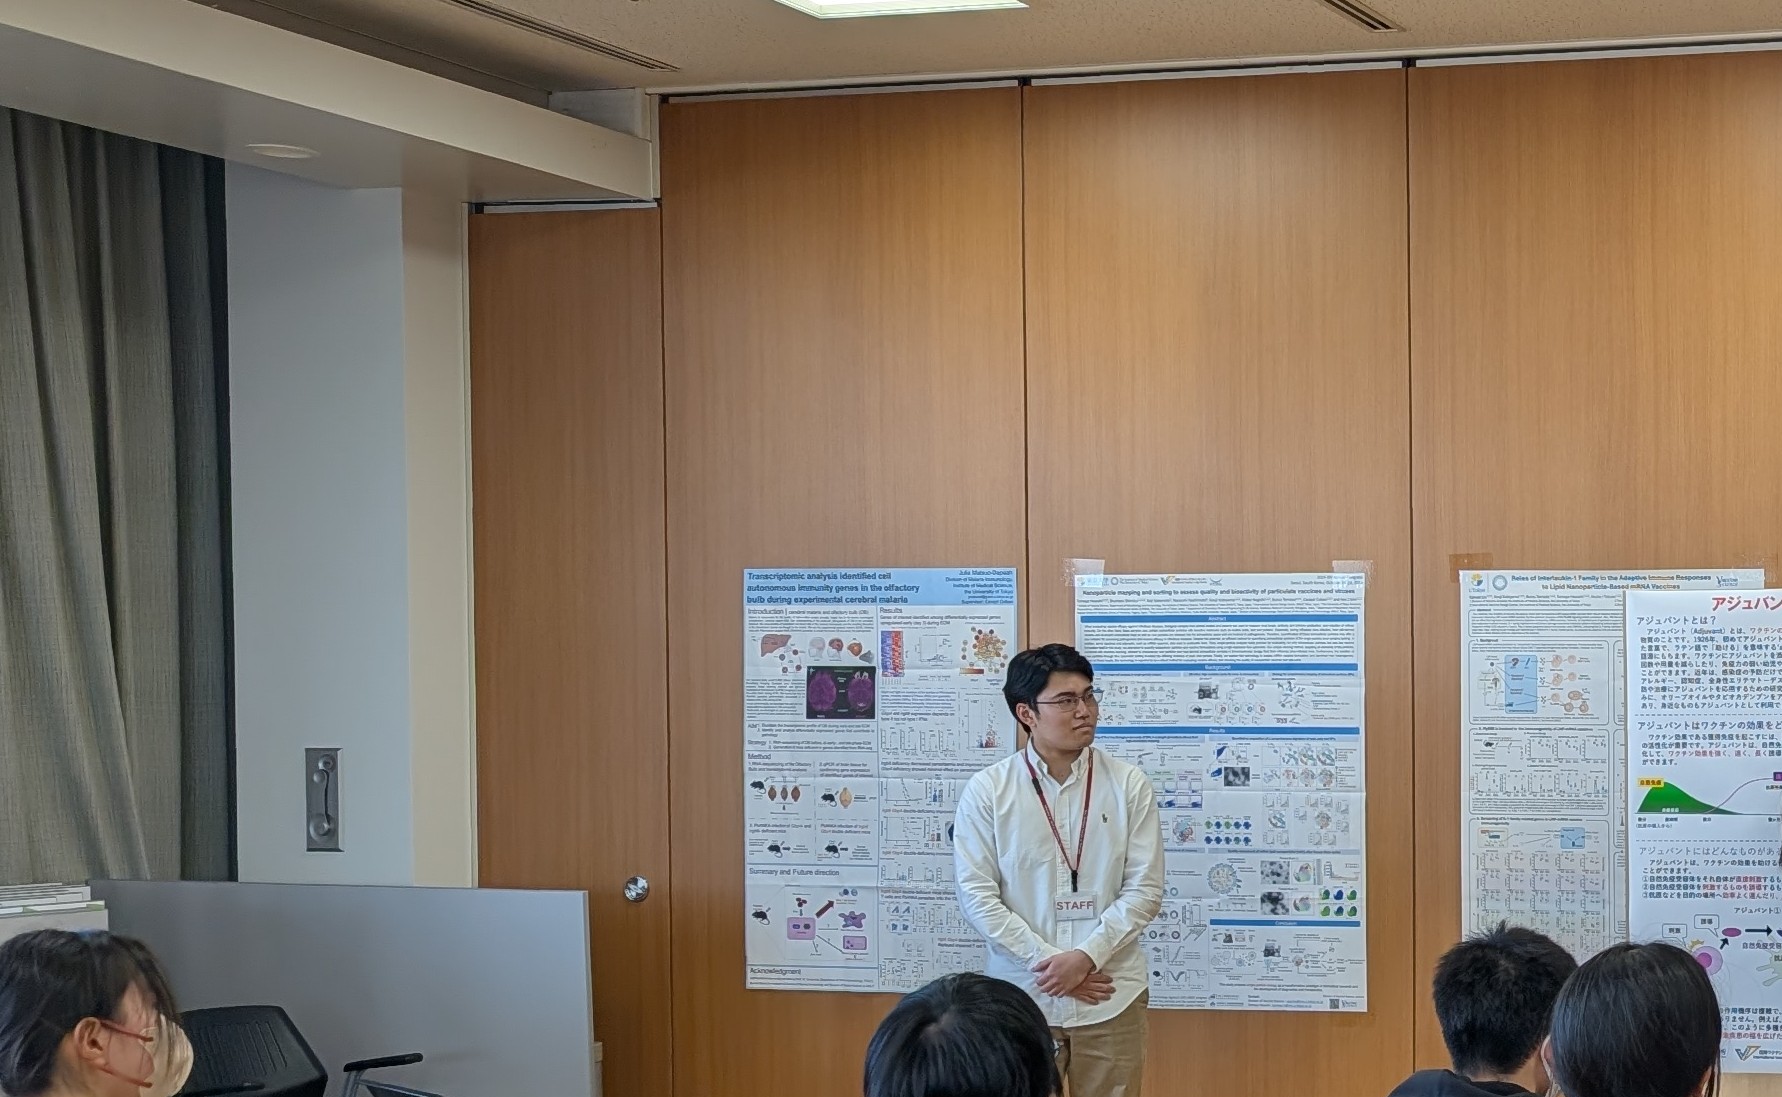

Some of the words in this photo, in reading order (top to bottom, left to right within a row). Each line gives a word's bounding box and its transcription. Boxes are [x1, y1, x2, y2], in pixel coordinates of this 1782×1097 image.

[747, 572, 805, 582] Transcriptomic
[807, 572, 838, 582] analysis
[839, 572, 877, 582] identified
[878, 572, 892, 582] cell
[1511, 574, 1528, 583] Roles
[1530, 574, 1536, 583] of
[1538, 574, 1577, 583] Interleukin-1
[1578, 574, 1598, 583] Family
[1600, 574, 1605, 583] in
[1607, 574, 1617, 583] the
[1619, 574, 1646, 583] Adaptive
[1648, 574, 1673, 583] Immune
[1675, 574, 1712, 583] Responses
[746, 584, 796, 594] autonomous
[798, 584, 833, 594] immunity
[835, 584, 859, 594] genes
[860, 584, 868, 594] in
[870, 584, 882, 594] the
[883, 584, 920, 594] olfactory
[746, 595, 765, 605] bulb
[767, 595, 792, 605] during
[794, 595, 843, 605] experimental
[845, 595, 877, 605] cerebral
[879, 595, 909, 605] malaria
[1637, 616, 1716, 626] アジュバントとは？
[1642, 758, 1678, 766] ができます。
[749, 868, 777, 877] Summary
[779, 868, 791, 877] and
[792, 868, 812, 877] Future
[814, 868, 840, 877] direction
[1056, 900, 1094, 910] STAFF
[1734, 906, 1782, 915] アジュバント①
